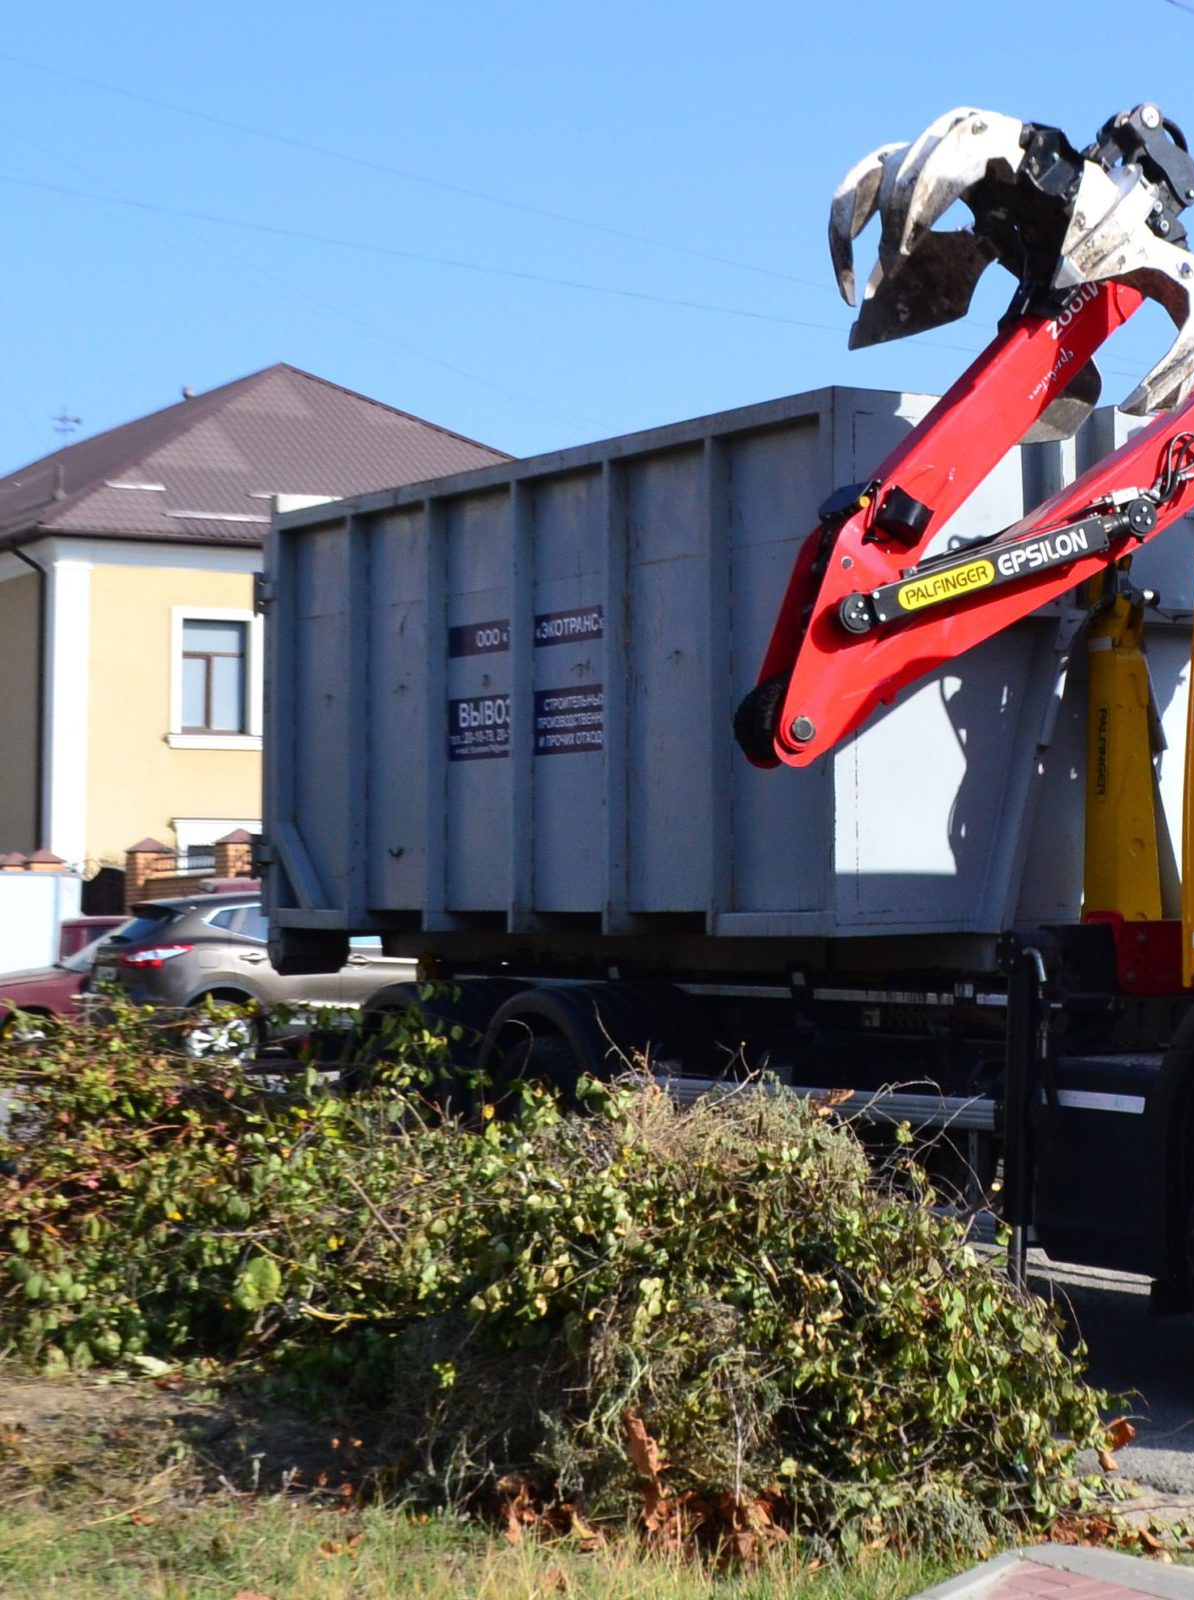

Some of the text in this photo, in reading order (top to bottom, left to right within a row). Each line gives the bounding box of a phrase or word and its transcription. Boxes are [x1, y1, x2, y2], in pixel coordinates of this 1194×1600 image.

[904, 528, 1088, 605] PALFINGER EPSILON
[476, 628, 500, 647] ООО
[1097, 707, 1109, 796] PALFINGER
